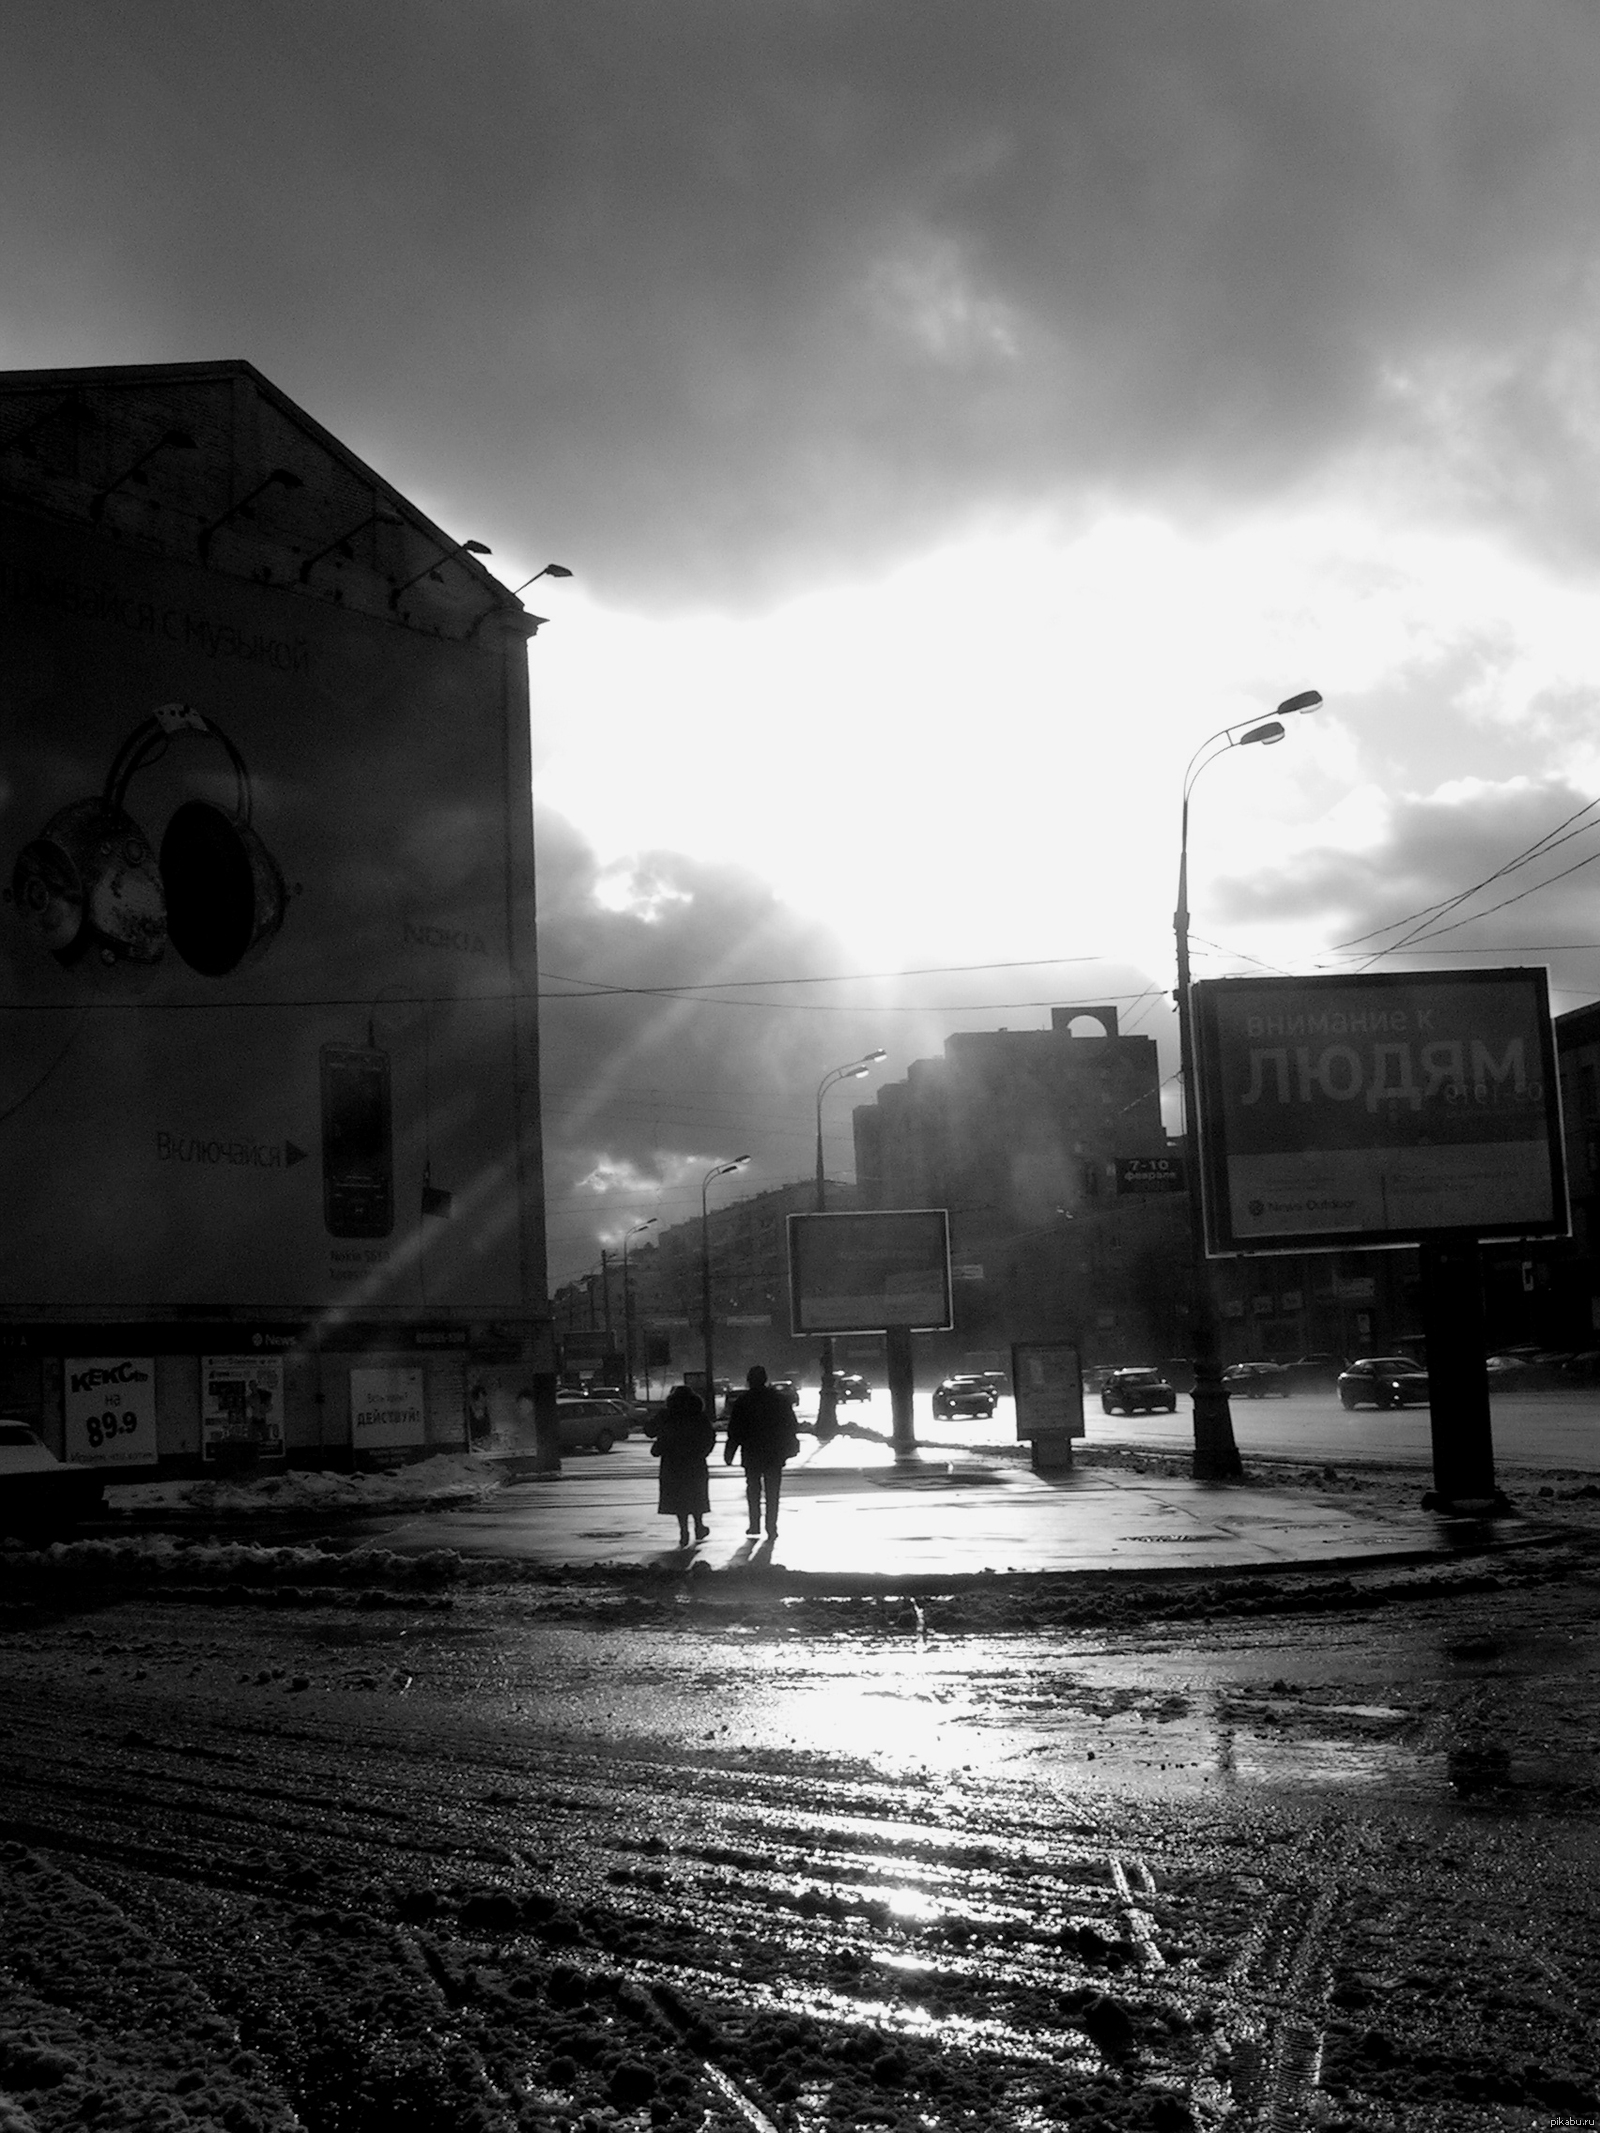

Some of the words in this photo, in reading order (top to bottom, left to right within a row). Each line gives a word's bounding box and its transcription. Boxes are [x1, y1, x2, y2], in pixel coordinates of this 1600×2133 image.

[184, 613, 310, 675] музыкой
[403, 922, 489, 956] NOKIA
[1247, 1008, 1407, 1038] внимание
[1240, 1037, 1527, 1113] ЛЮДЯМ
[155, 1131, 282, 1168] Включайся
[1128, 1159, 1169, 1171] 7-10
[265, 1333, 297, 1346] News
[104, 1394, 121, 1408] на
[357, 1406, 420, 1428] ДЕЙСТВУЙ!
[86, 1411, 137, 1448] 89.9
